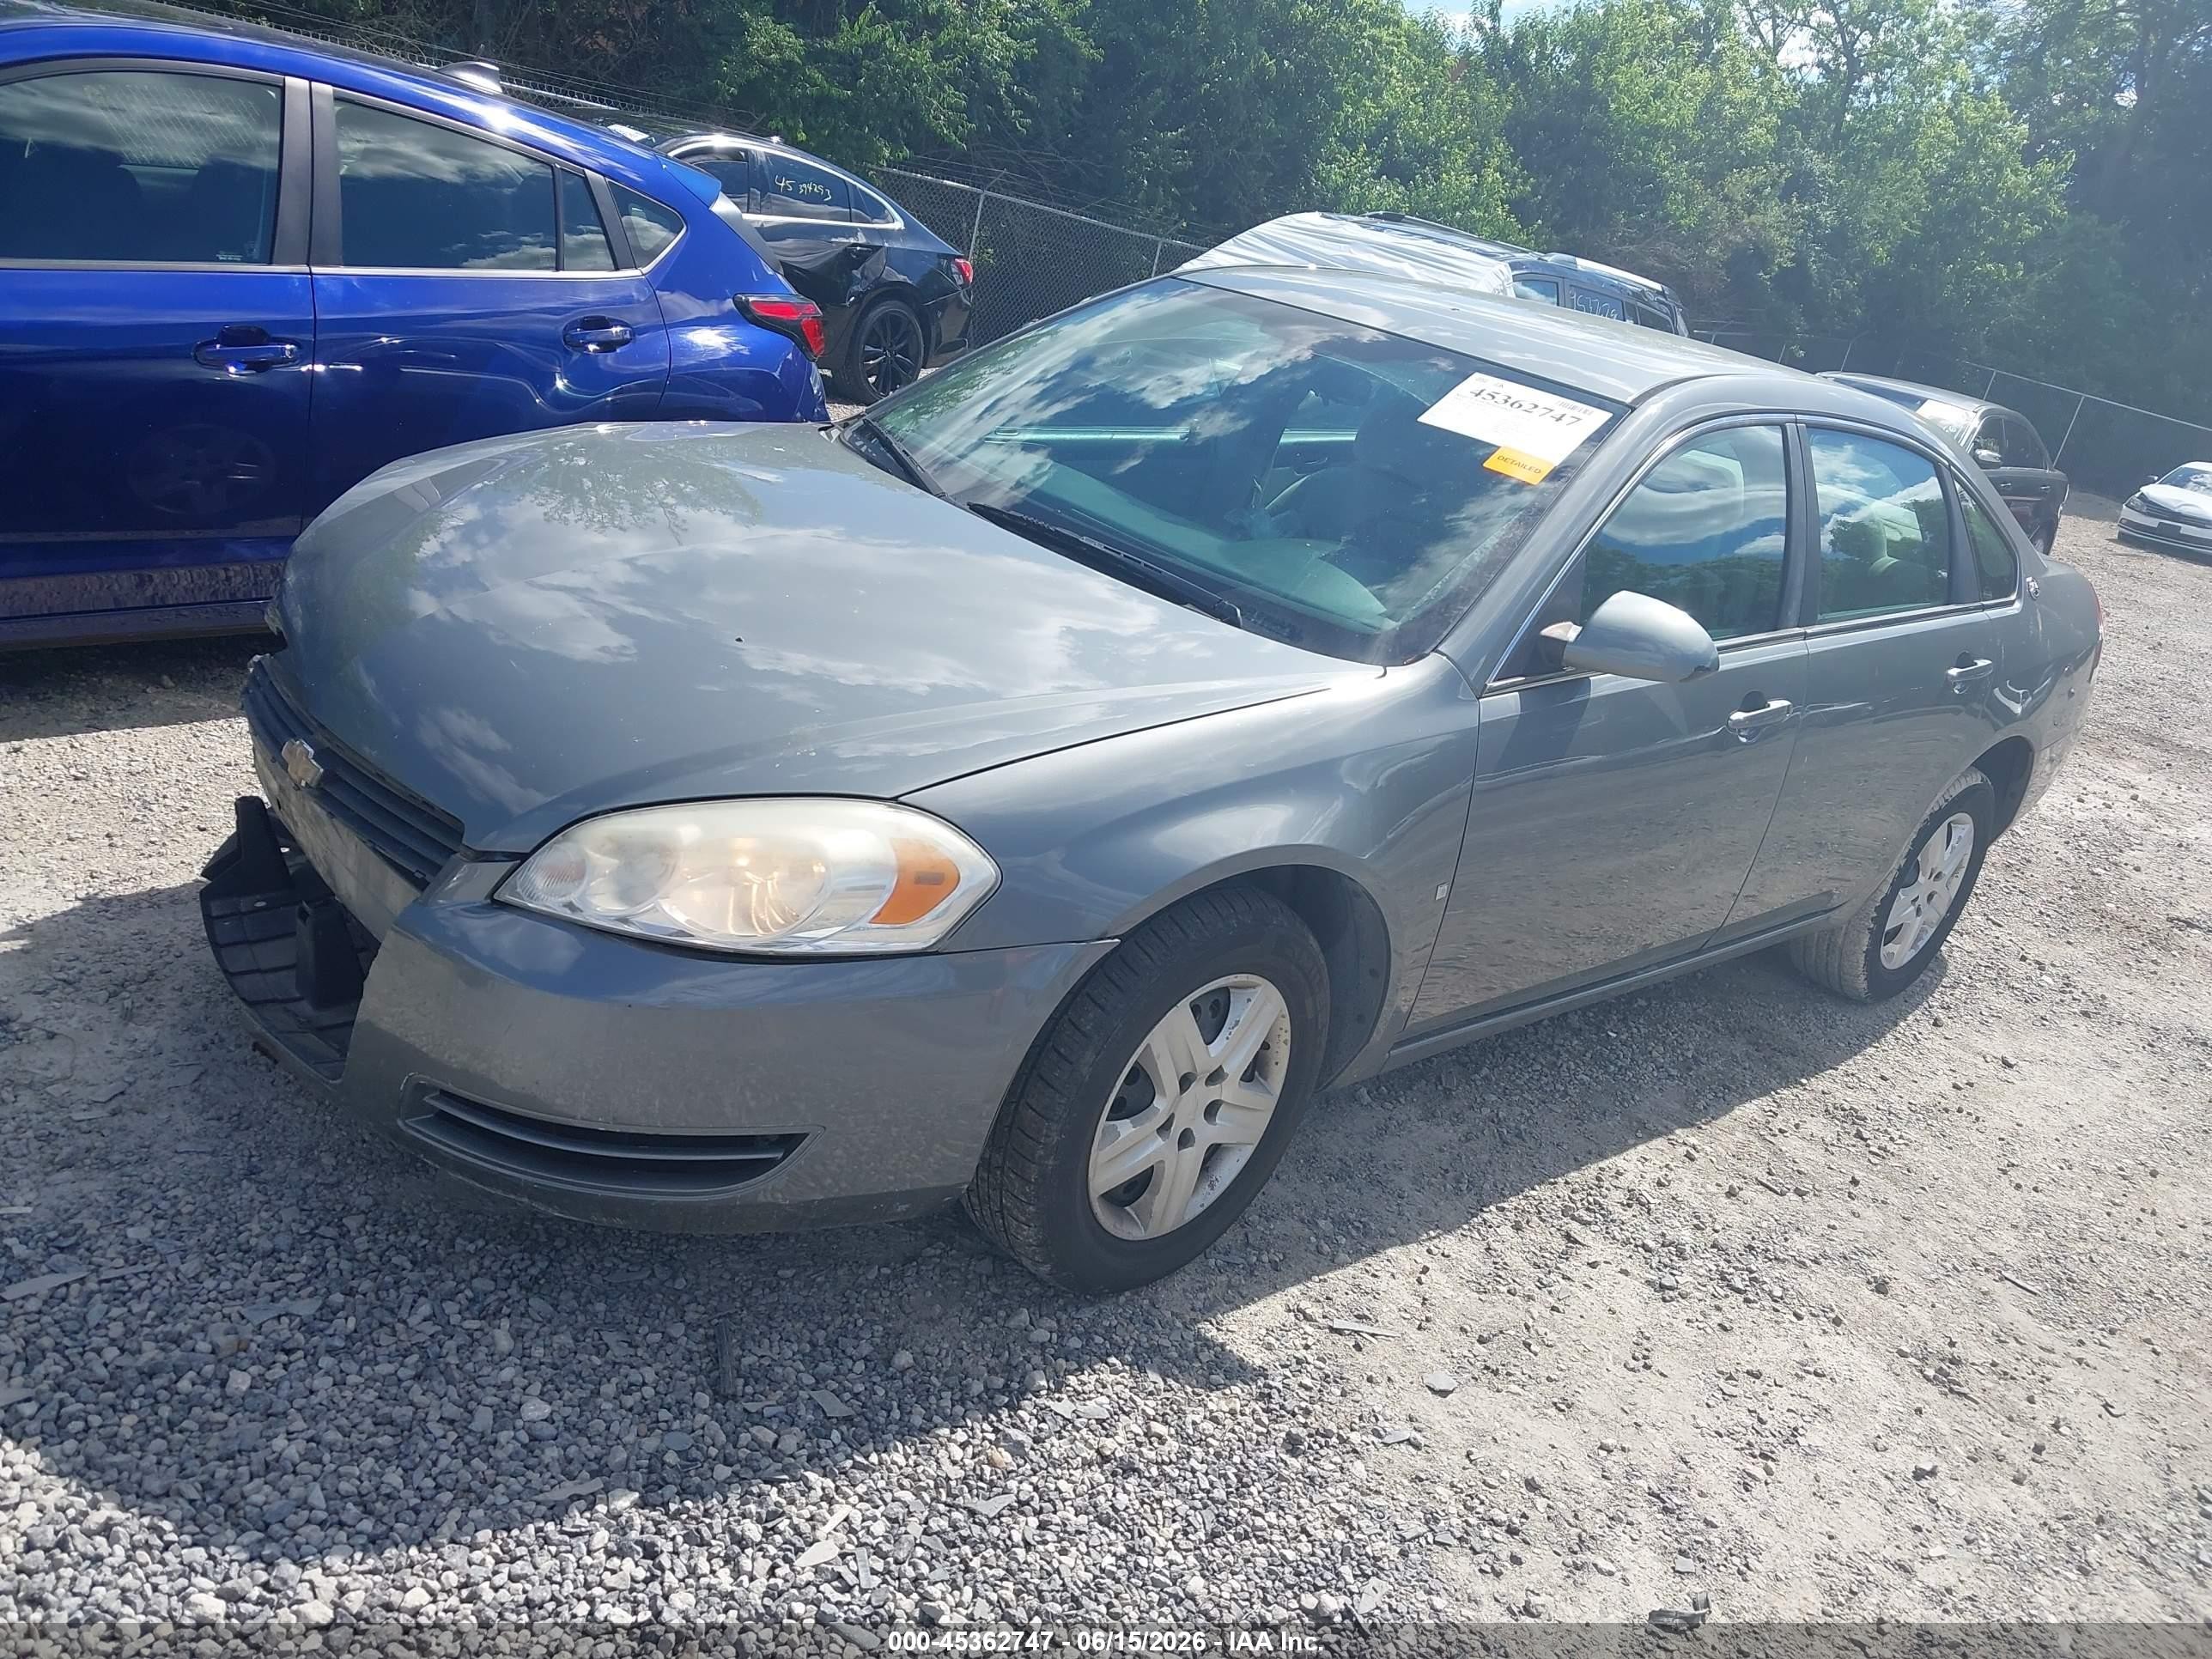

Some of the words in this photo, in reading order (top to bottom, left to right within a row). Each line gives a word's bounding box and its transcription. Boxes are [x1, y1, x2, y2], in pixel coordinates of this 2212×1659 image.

[775, 174, 796, 193] 45
[1469, 387, 1583, 427] 45362747
[1497, 454, 1542, 475] DETAILED
